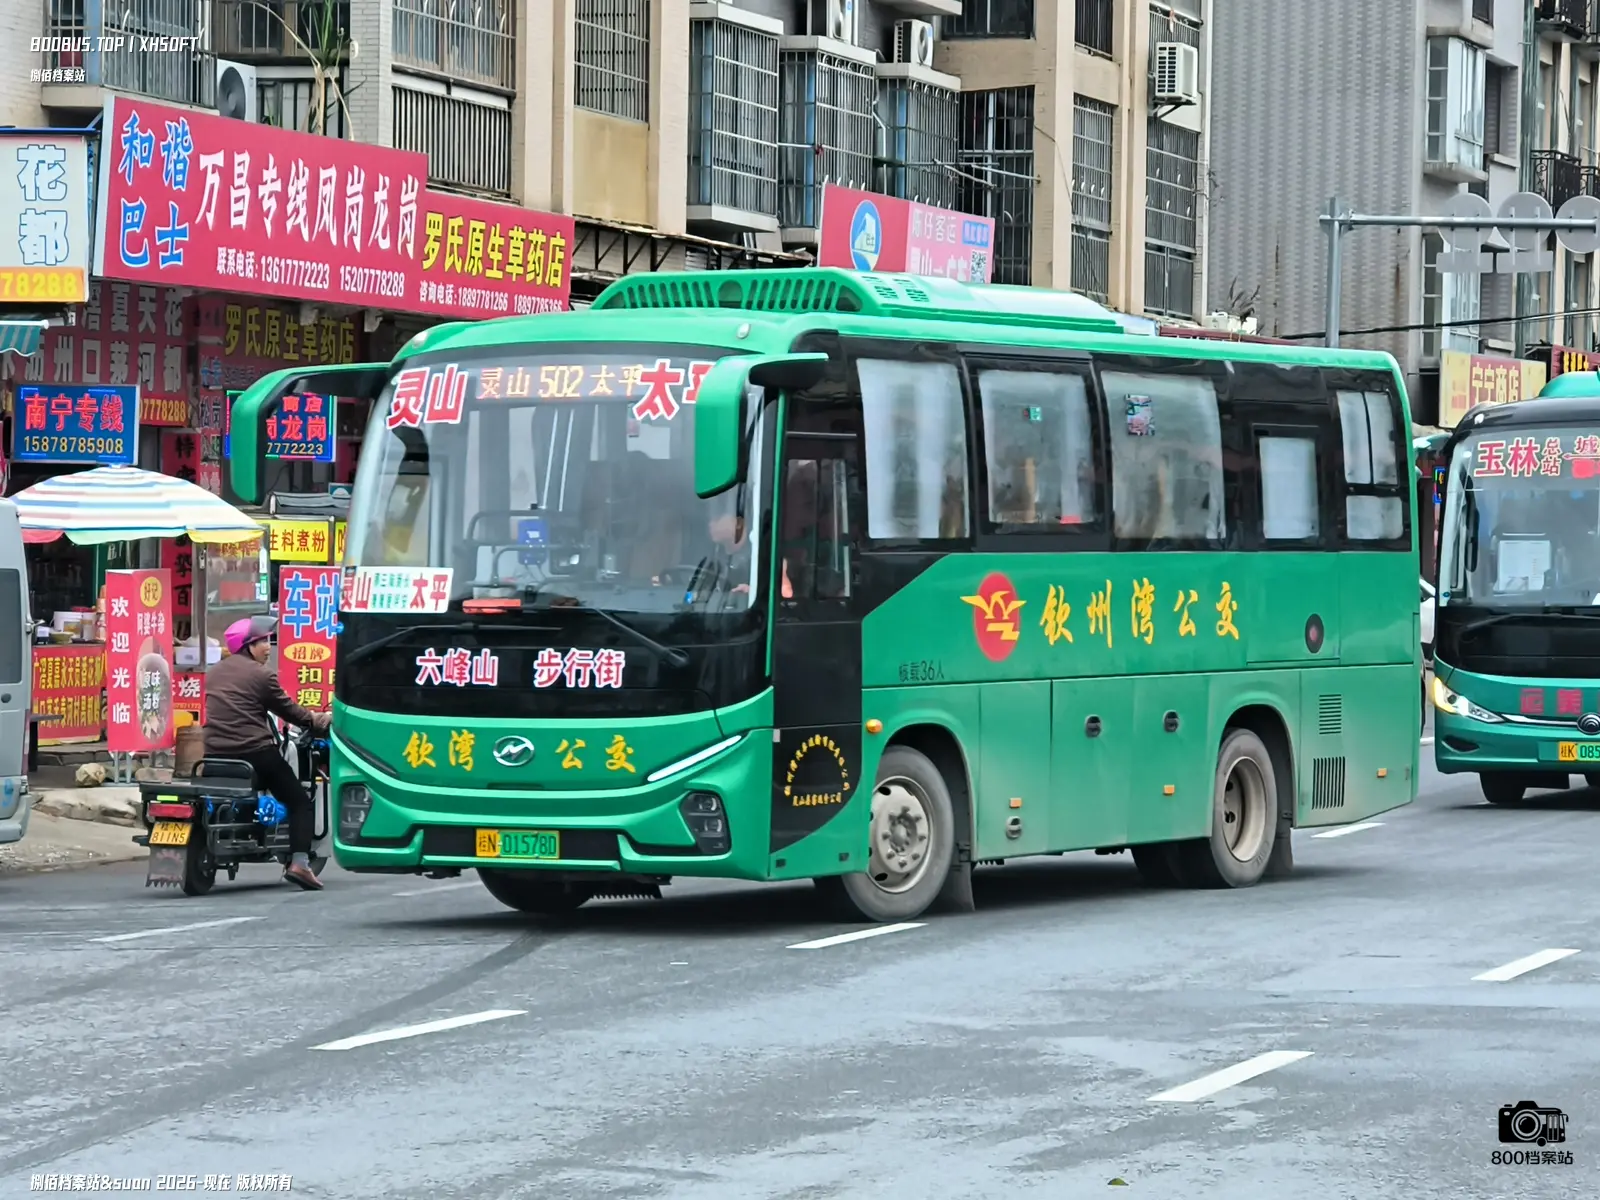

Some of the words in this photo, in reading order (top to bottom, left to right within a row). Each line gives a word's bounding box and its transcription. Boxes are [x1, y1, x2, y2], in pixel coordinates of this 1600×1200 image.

[119, 110, 194, 192] 和谐
[17, 144, 68, 266] 花都
[195, 149, 419, 260] 万昌专线凤岗龙岗
[119, 198, 190, 268] 巴士
[422, 211, 566, 288] 罗氏原生草药店
[340, 265, 405, 297] 15207778288
[225, 304, 355, 363] 罗氏原生草药店
[386, 363, 468, 429] 灵山
[476, 367, 530, 399] 灵山
[538, 366, 584, 398] 502
[589, 364, 643, 396] 太平
[24, 393, 125, 433] 南宁专线
[24, 436, 124, 454] 15878785908
[1474, 437, 1540, 477] 玉林
[410, 572, 449, 611] 太平
[1040, 577, 1240, 649] 钦州湾公交
[111, 596, 130, 724] 欢迎光临
[292, 646, 324, 660] 招牌
[415, 647, 499, 686] 六峰山
[533, 648, 625, 688] 步行街
[555, 734, 636, 773] 公交
